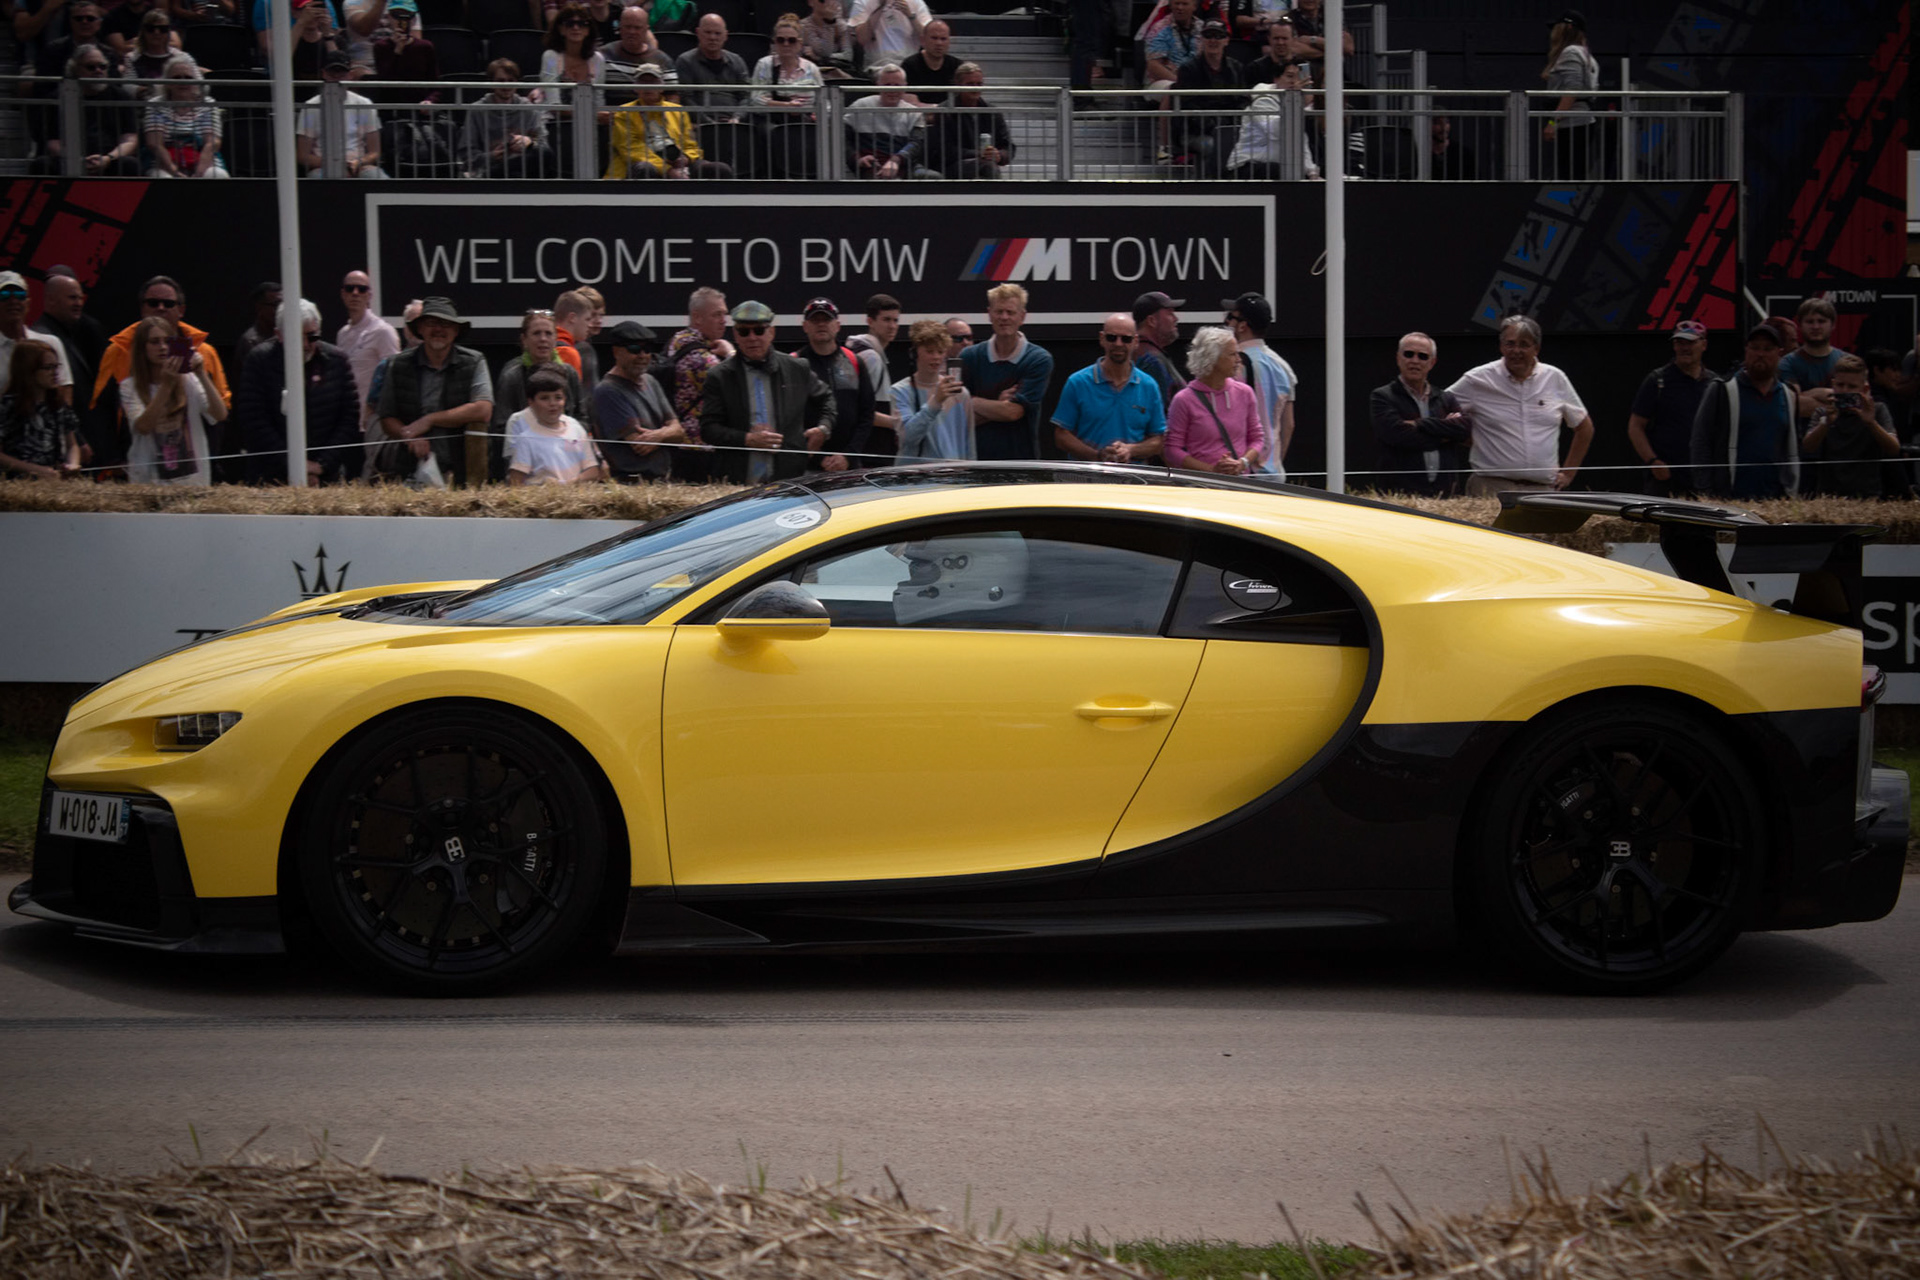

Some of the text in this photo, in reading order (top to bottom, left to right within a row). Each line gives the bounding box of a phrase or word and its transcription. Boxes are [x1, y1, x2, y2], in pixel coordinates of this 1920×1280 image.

[415, 236, 1230, 284] WELCOME TO BMW M TOWN
[1837, 289, 1877, 303] TOWN
[524, 832, 538, 872] BGATTI
